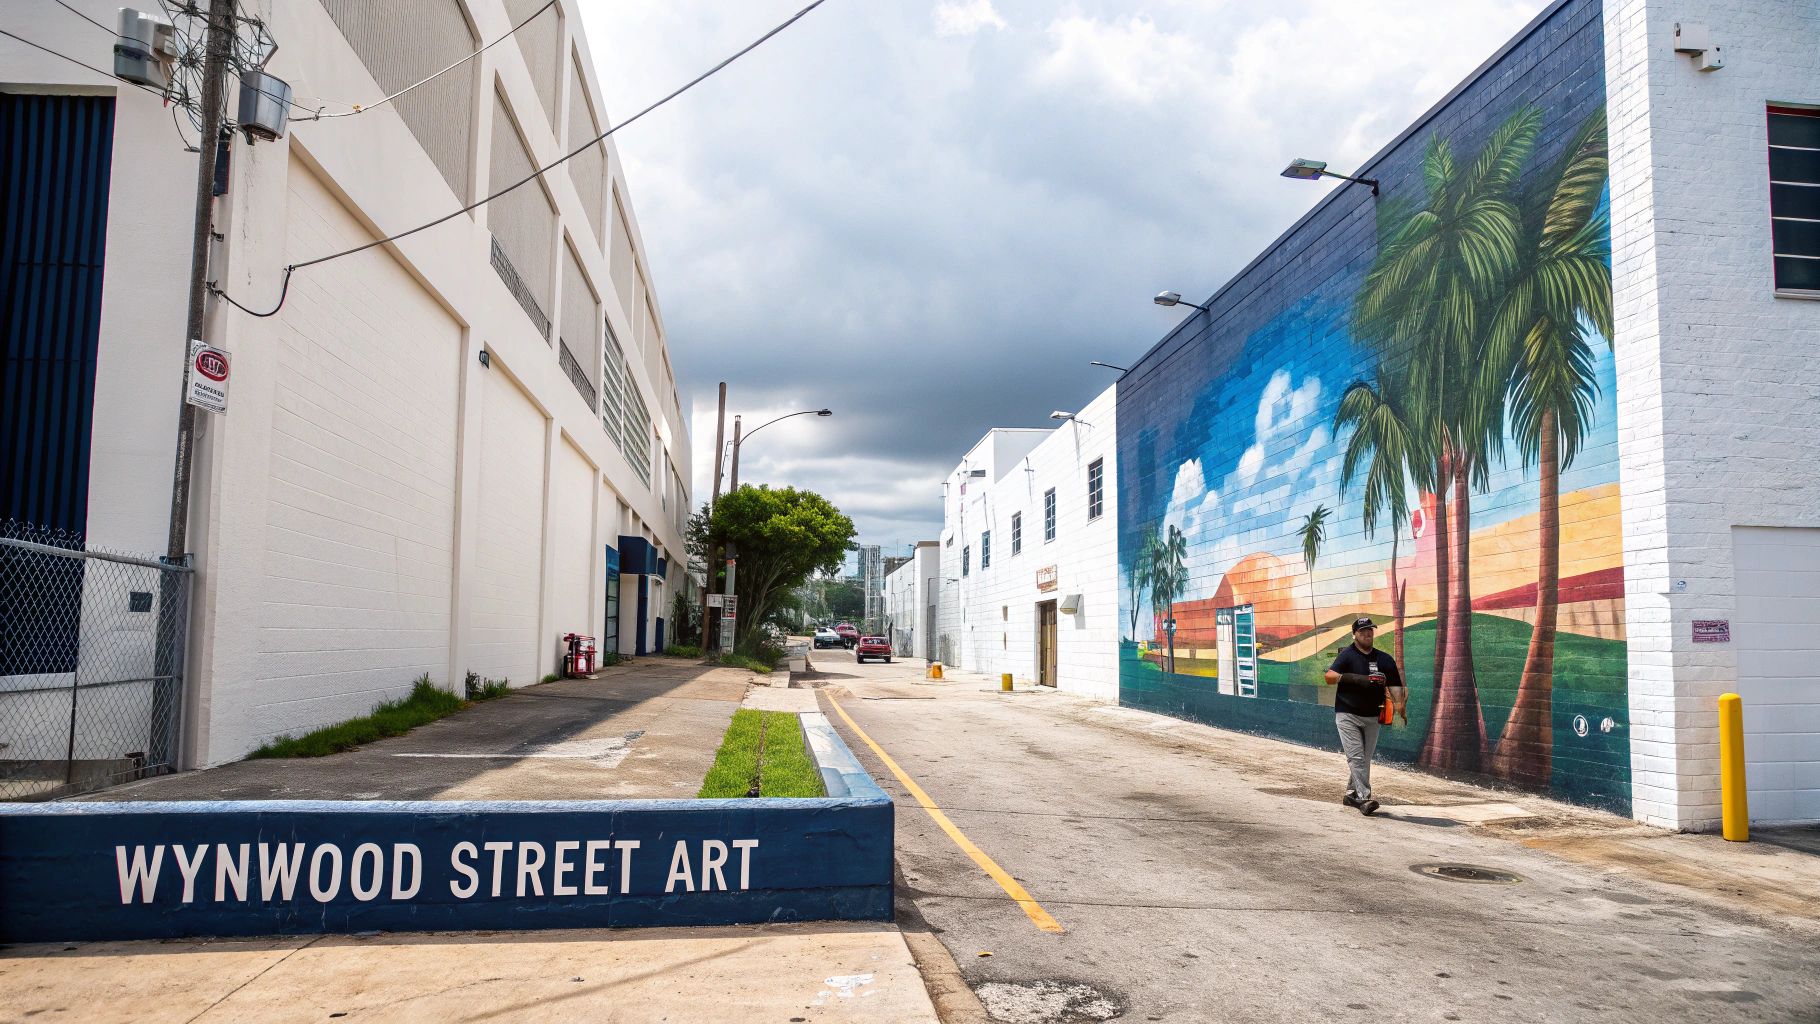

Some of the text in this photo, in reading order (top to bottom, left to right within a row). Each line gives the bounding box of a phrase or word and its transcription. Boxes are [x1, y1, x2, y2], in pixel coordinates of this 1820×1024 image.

[115, 839, 760, 904] WYNWOOD STREET ART
